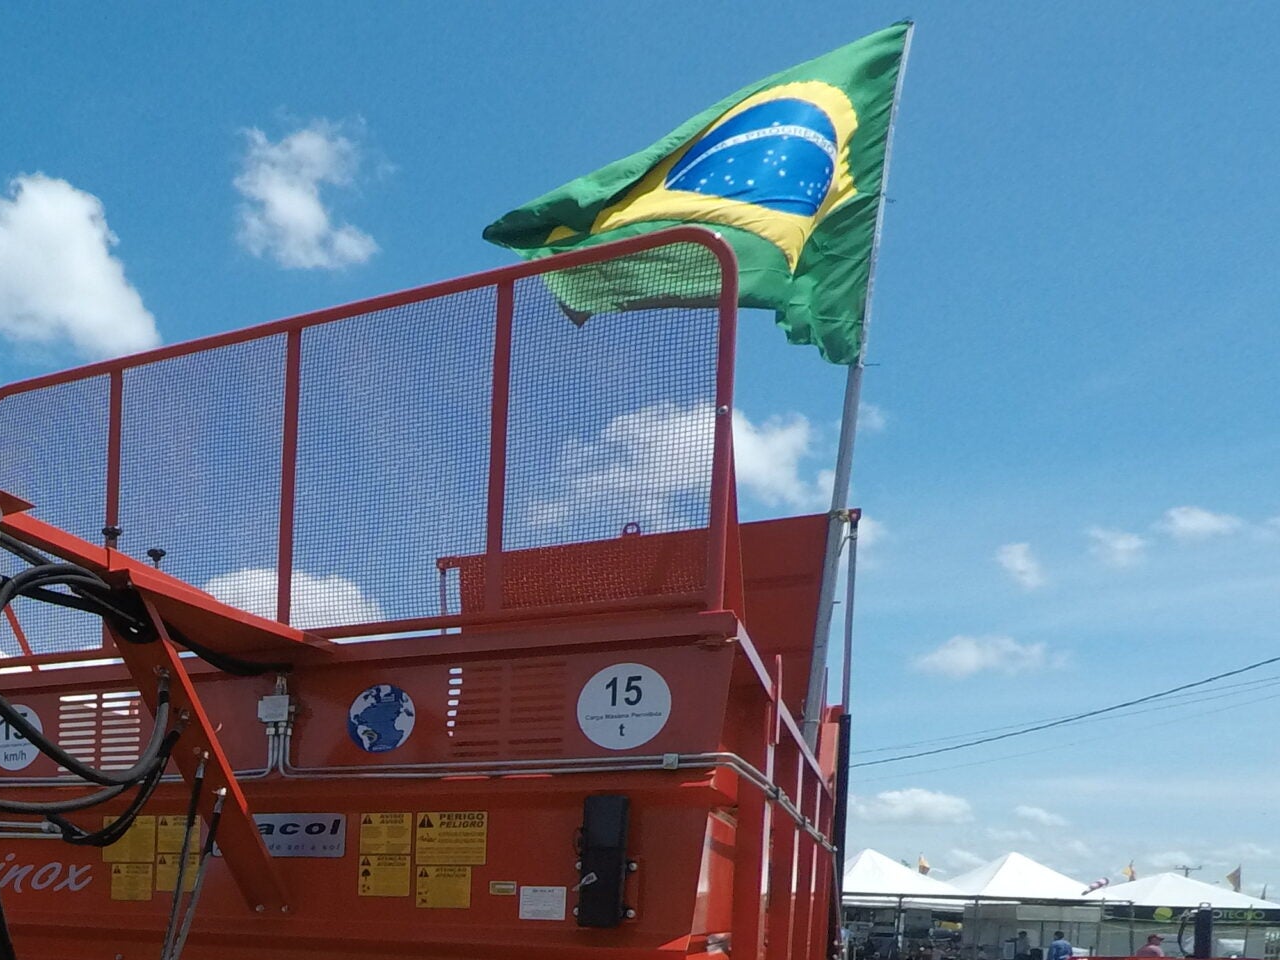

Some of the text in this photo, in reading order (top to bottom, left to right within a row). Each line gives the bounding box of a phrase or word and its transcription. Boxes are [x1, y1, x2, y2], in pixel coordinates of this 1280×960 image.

[605, 675, 642, 707] 15
[618, 723, 625, 737] t
[3, 750, 27, 763] km/h
[256, 819, 341, 836] acol
